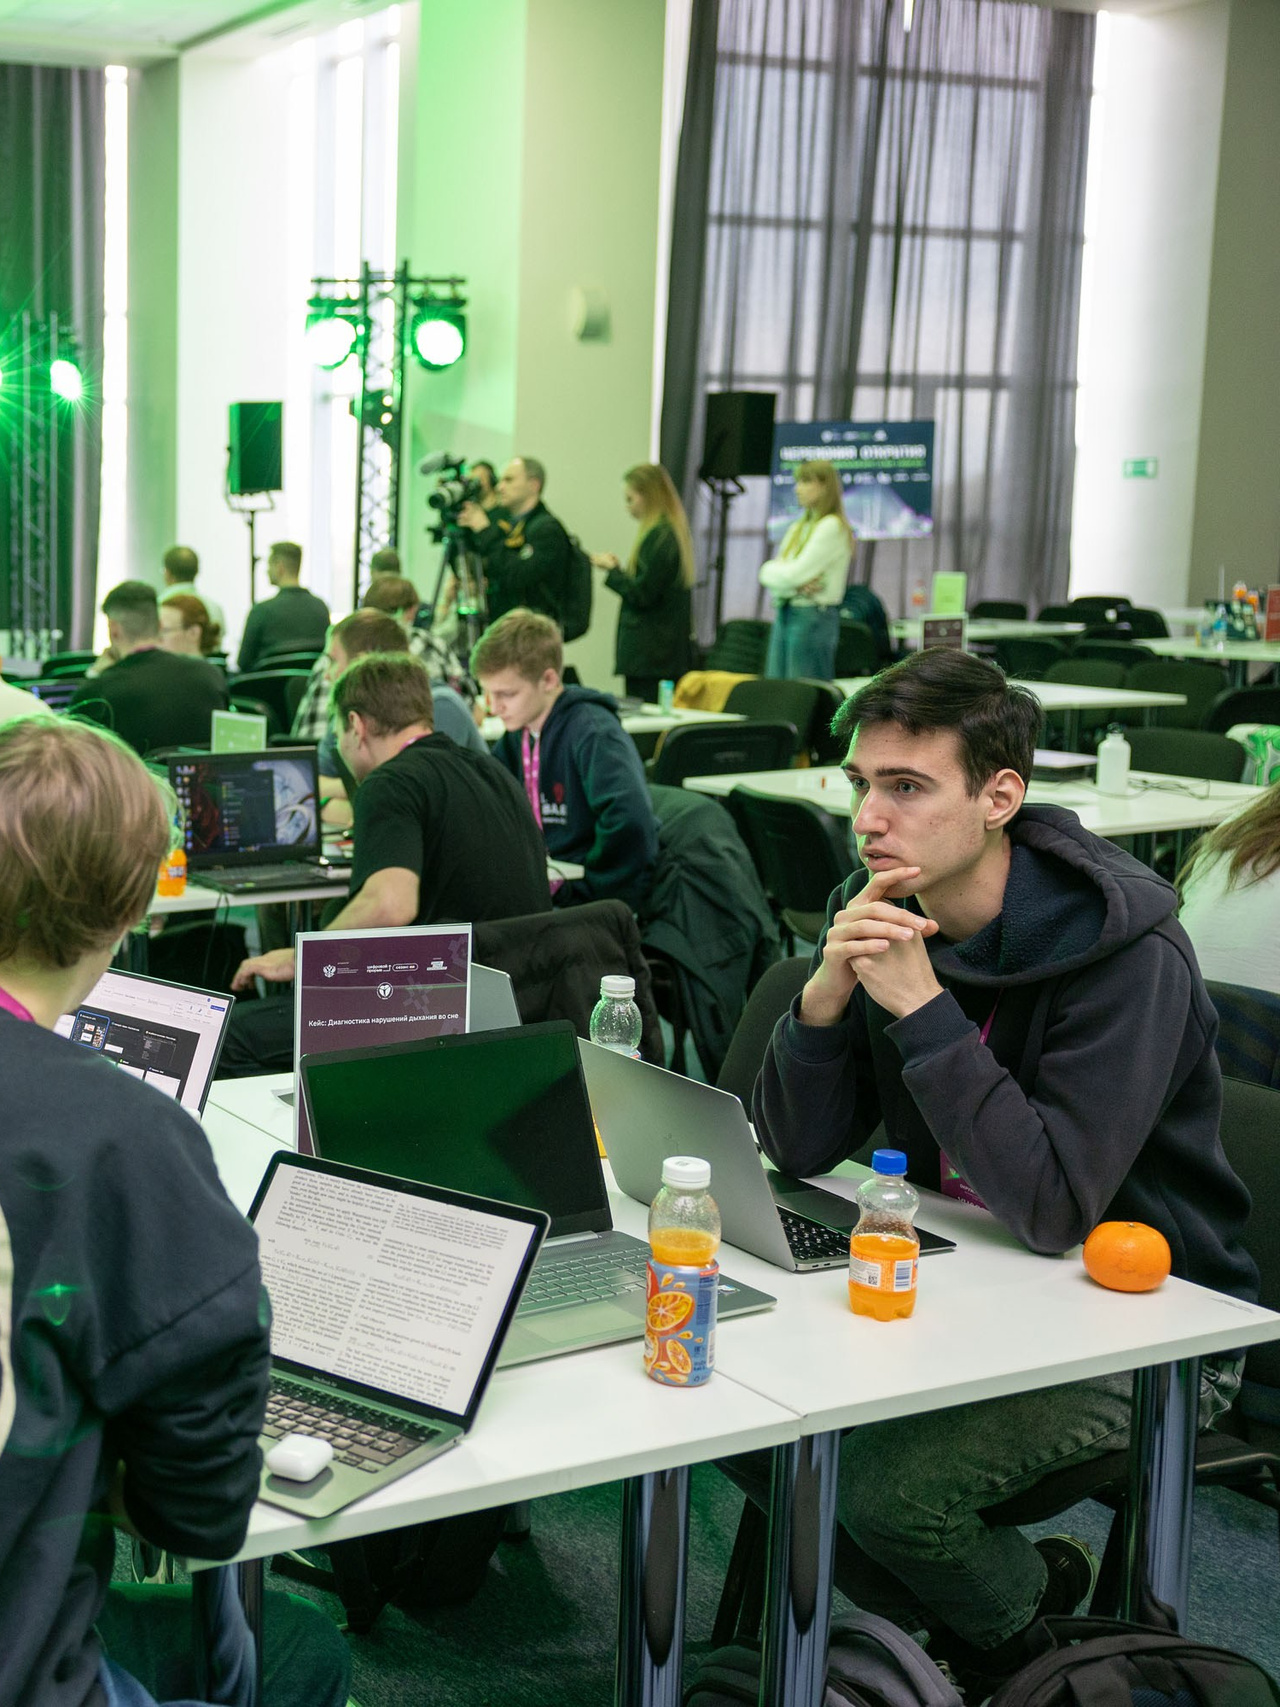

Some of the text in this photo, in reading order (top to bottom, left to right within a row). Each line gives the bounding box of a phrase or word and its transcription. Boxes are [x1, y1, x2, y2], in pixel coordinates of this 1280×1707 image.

[308, 1019, 327, 1027] Кейс:
[328, 1017, 370, 1027] Диагностика
[371, 1014, 408, 1025] нарушений
[409, 1014, 437, 1022] дыхания
[447, 1012, 459, 1020] сне
